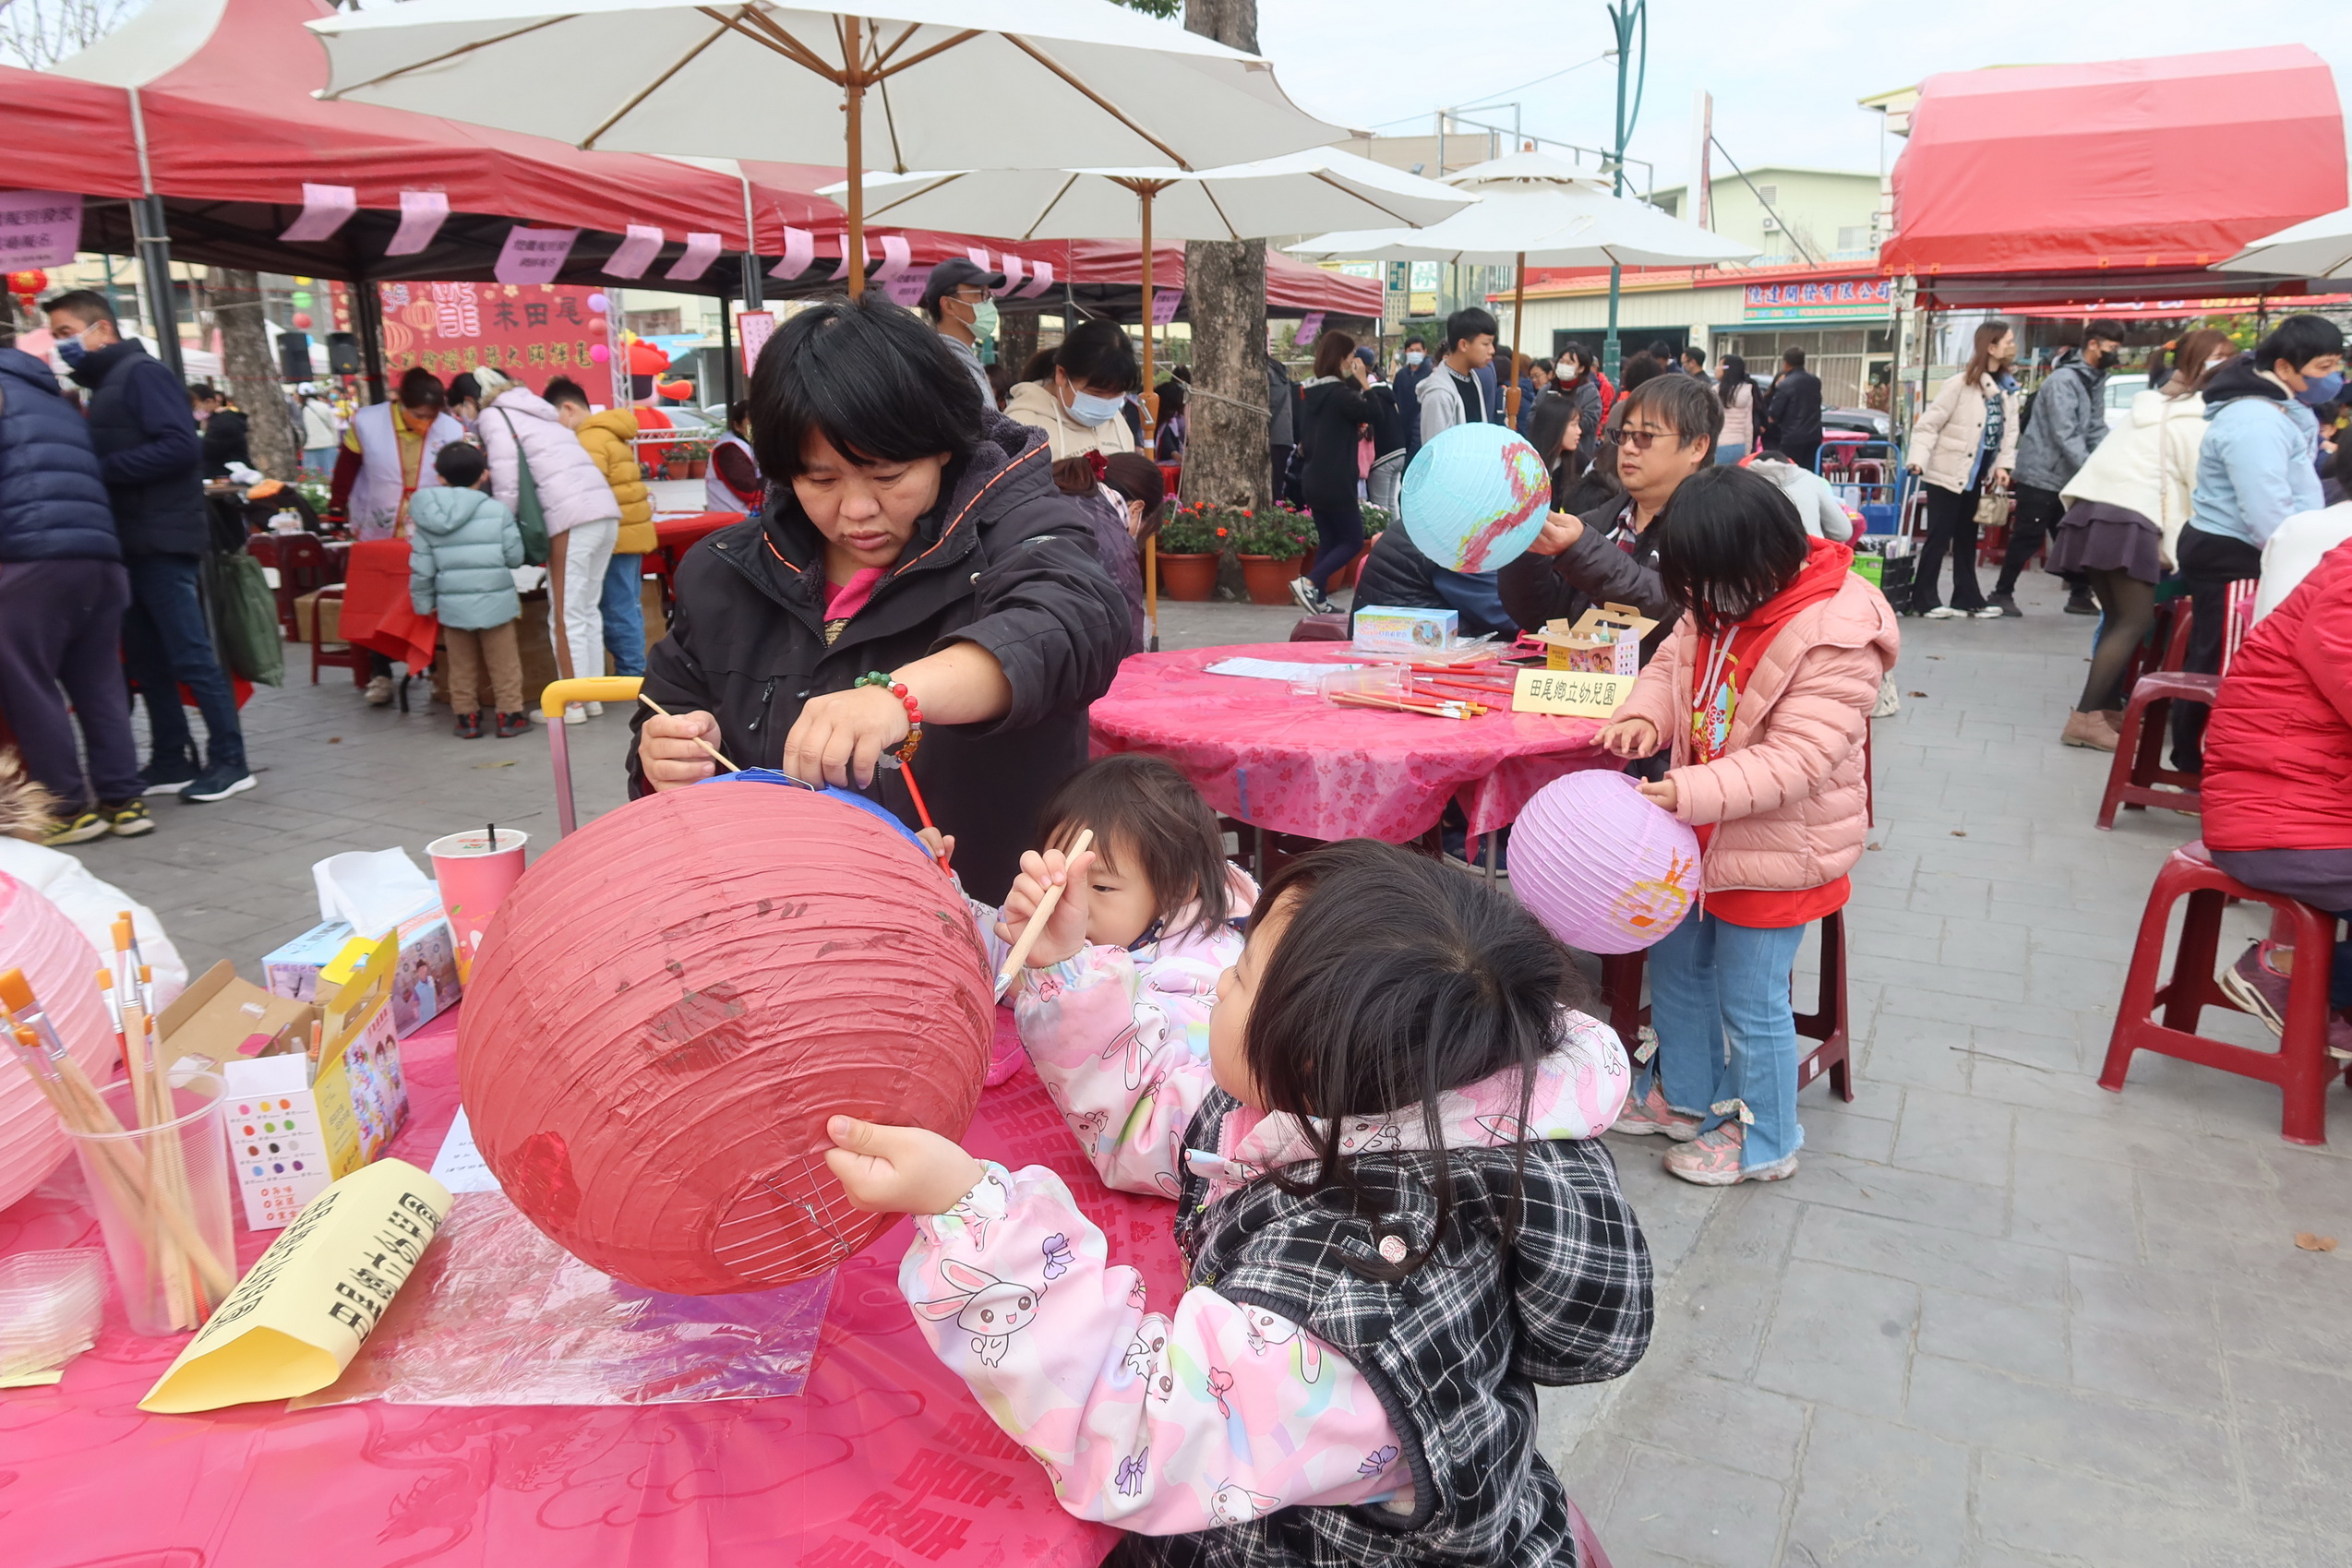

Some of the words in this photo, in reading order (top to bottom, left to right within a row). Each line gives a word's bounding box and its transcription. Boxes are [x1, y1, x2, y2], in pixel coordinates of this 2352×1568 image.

[1530, 677, 1617, 707] 田尾鄉立幼兒園
